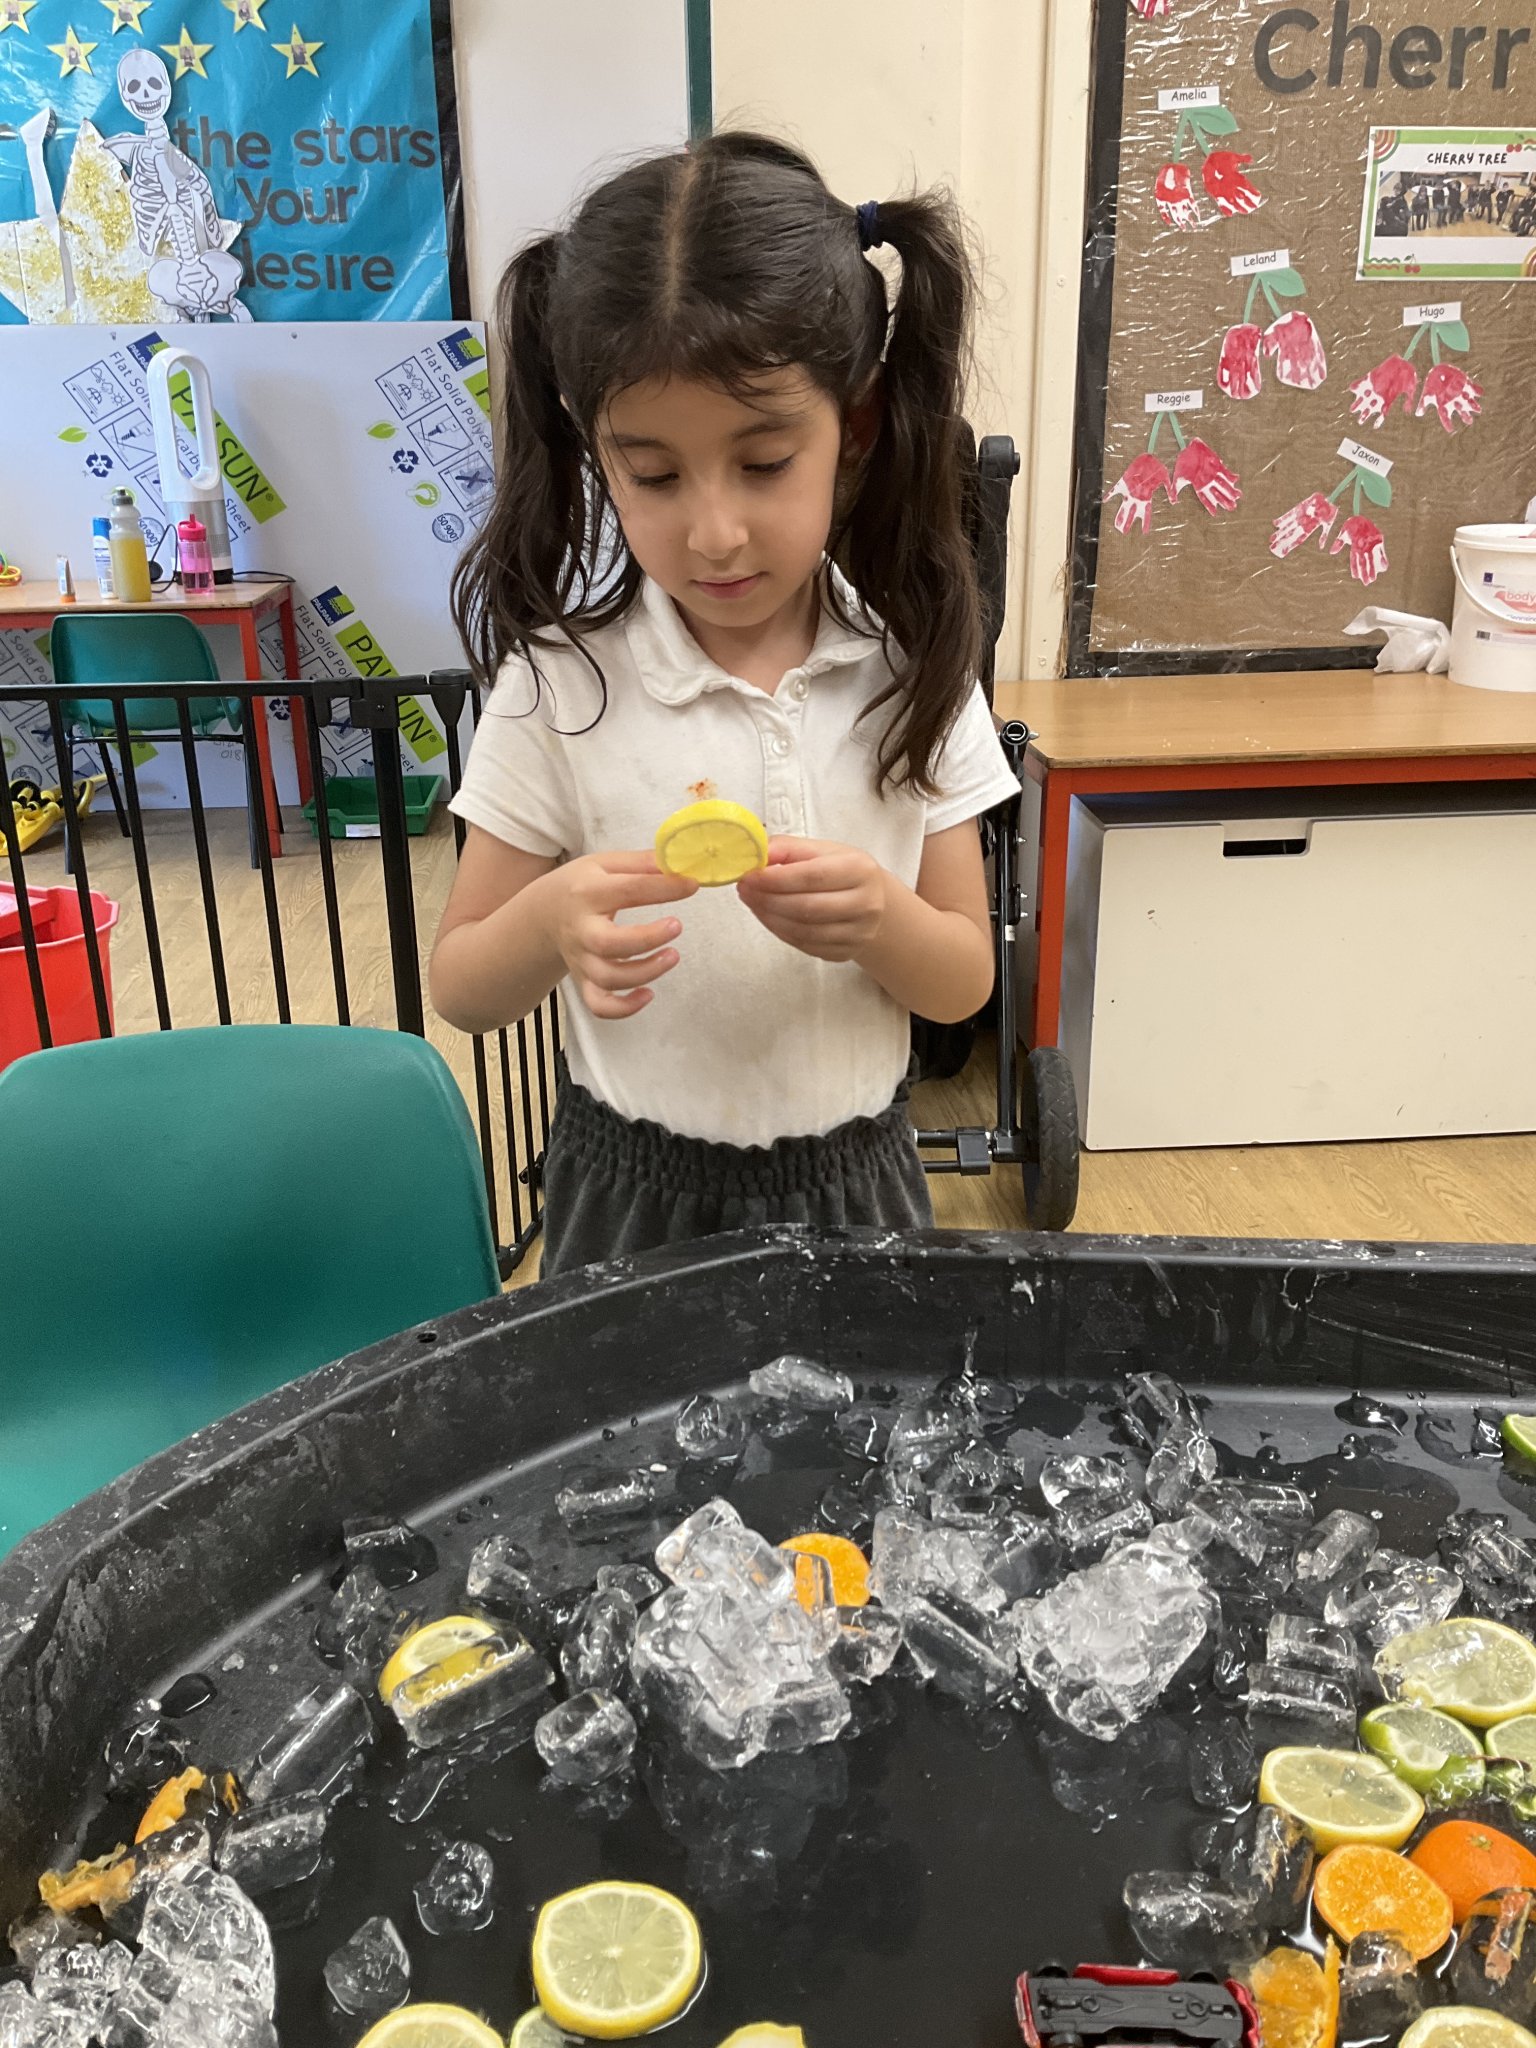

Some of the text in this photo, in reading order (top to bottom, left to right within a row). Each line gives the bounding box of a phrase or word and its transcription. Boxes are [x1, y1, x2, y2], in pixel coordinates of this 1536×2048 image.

[1254, 0, 1531, 94] Cherr
[1171, 88, 1207, 101] Amelia
[173, 116, 436, 169] the stars
[1427, 152, 1508, 165] CHERRY TREE
[1243, 252, 1277, 267] Leland
[1420, 306, 1445, 318] Hugo
[110, 351, 133, 376] Flat
[128, 344, 150, 370] PALRA
[440, 340, 463, 370] PALRAM
[421, 347, 442, 373] Flat
[439, 374, 466, 407] Solid
[1157, 392, 1191, 406] Reggie
[1352, 445, 1380, 465] Jaxon
[312, 598, 335, 626] PALRAM
[295, 604, 315, 629] Flat
[312, 628, 338, 659] Solid
[10, 635, 36, 666] Solid
